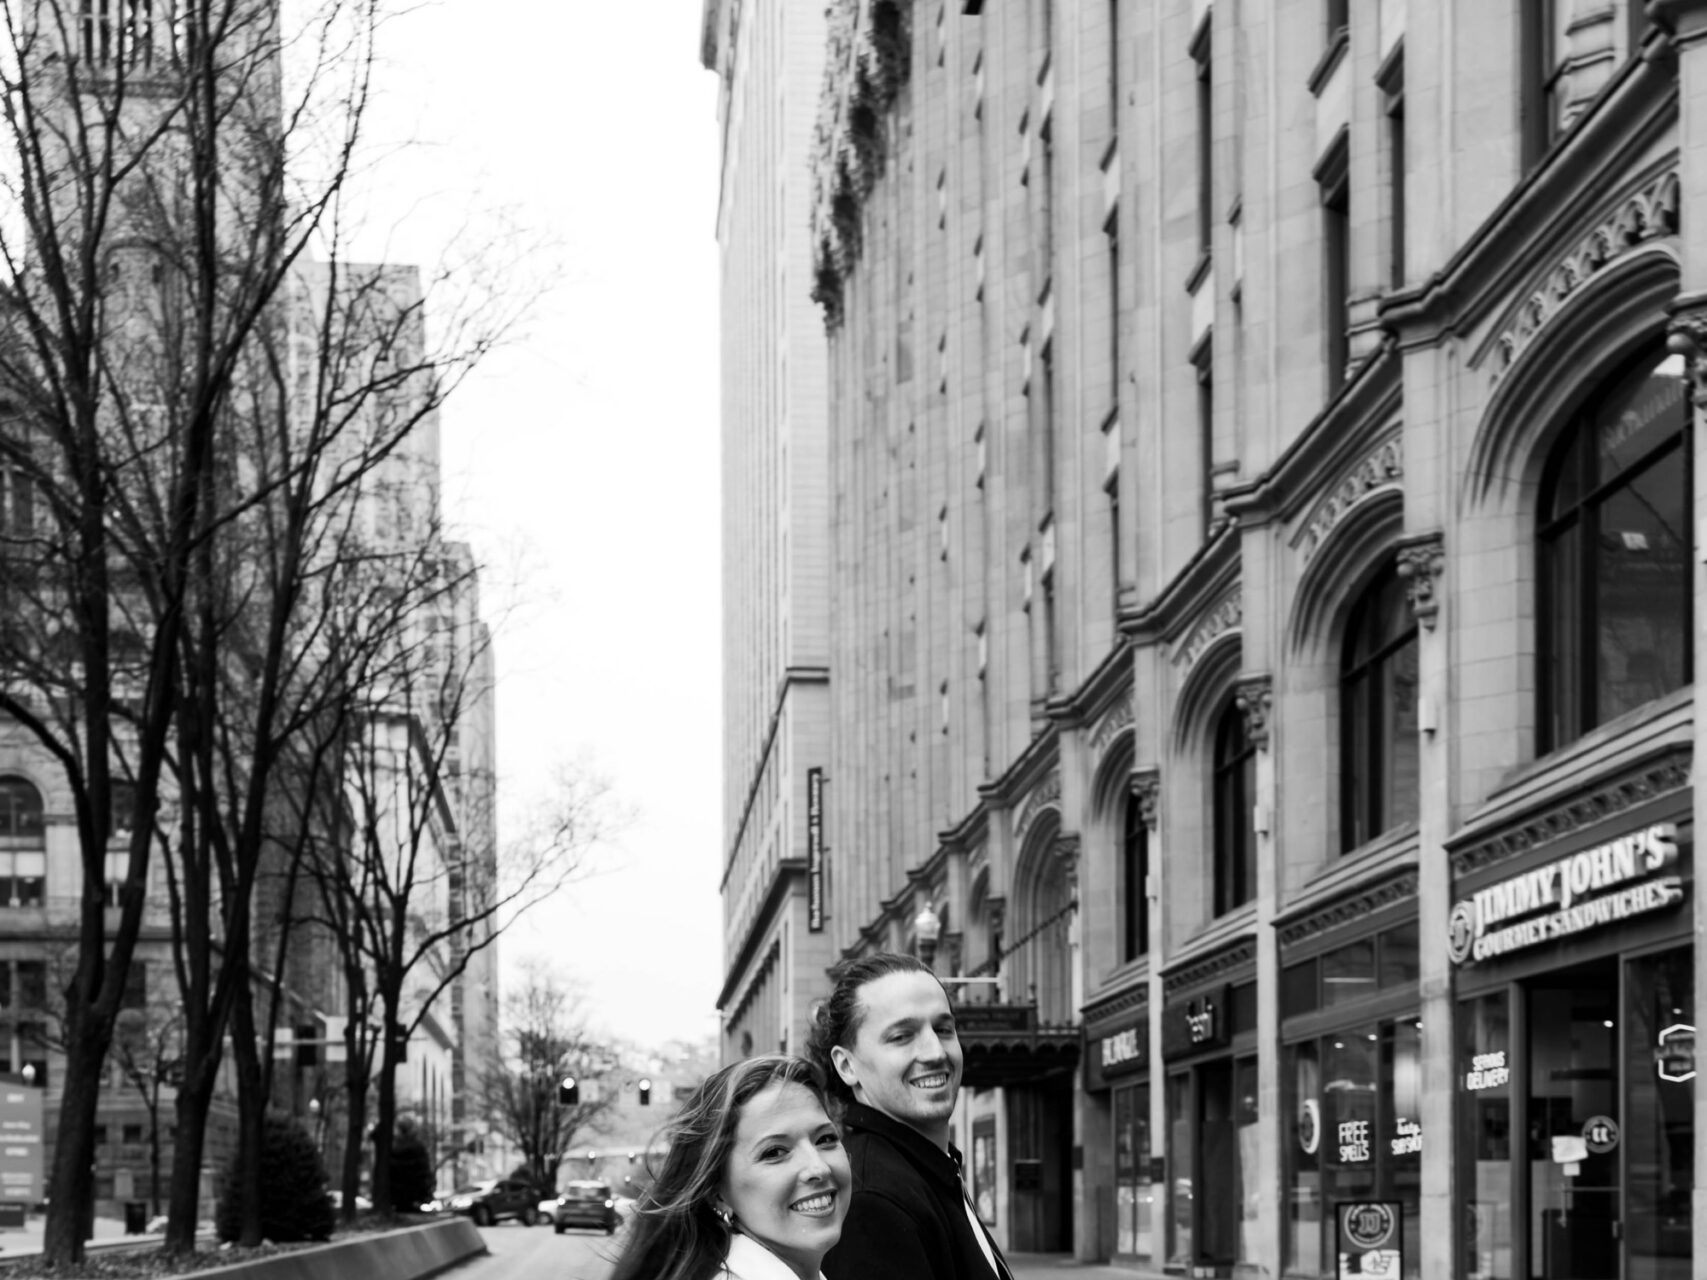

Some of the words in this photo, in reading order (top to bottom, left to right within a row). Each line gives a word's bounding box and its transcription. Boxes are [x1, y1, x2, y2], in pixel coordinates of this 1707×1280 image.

[1473, 865, 1556, 938] JIMMY
[1559, 823, 1676, 909] JOHN'S
[1473, 916, 1546, 960] GOURMET
[1548, 876, 1681, 938] SANDWICHES
[1339, 1121, 1368, 1145] FREE
[1340, 1140, 1369, 1162] SMELLS
